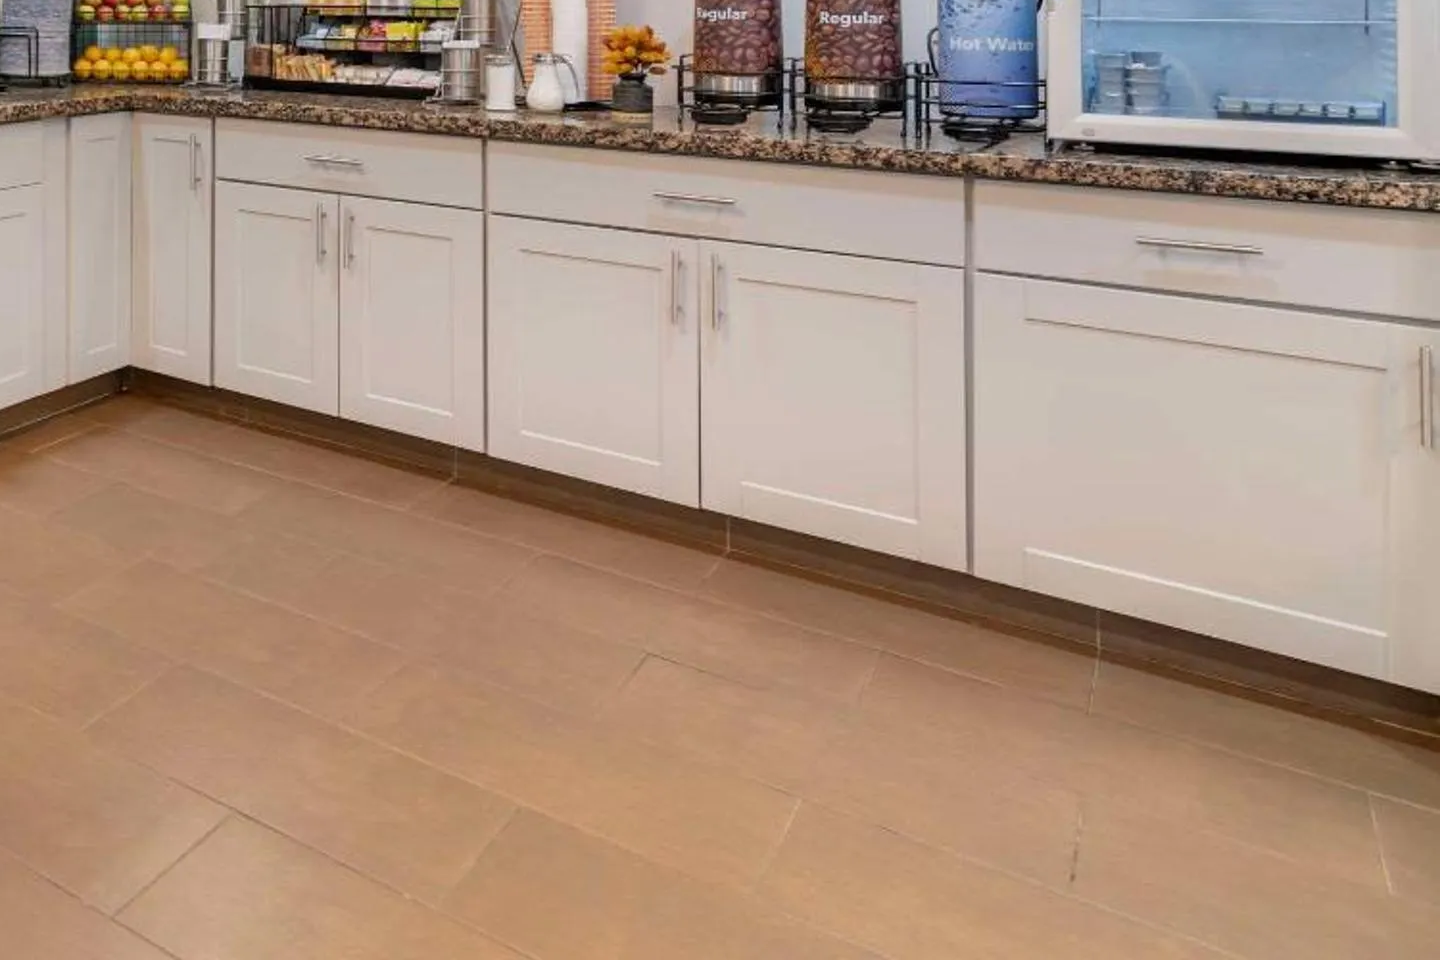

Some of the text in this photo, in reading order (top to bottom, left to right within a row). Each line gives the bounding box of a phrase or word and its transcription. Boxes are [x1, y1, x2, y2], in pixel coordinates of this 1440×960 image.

[696, 7, 749, 22] Regular
[819, 11, 885, 28] Regular
[949, 37, 980, 51] Hot
